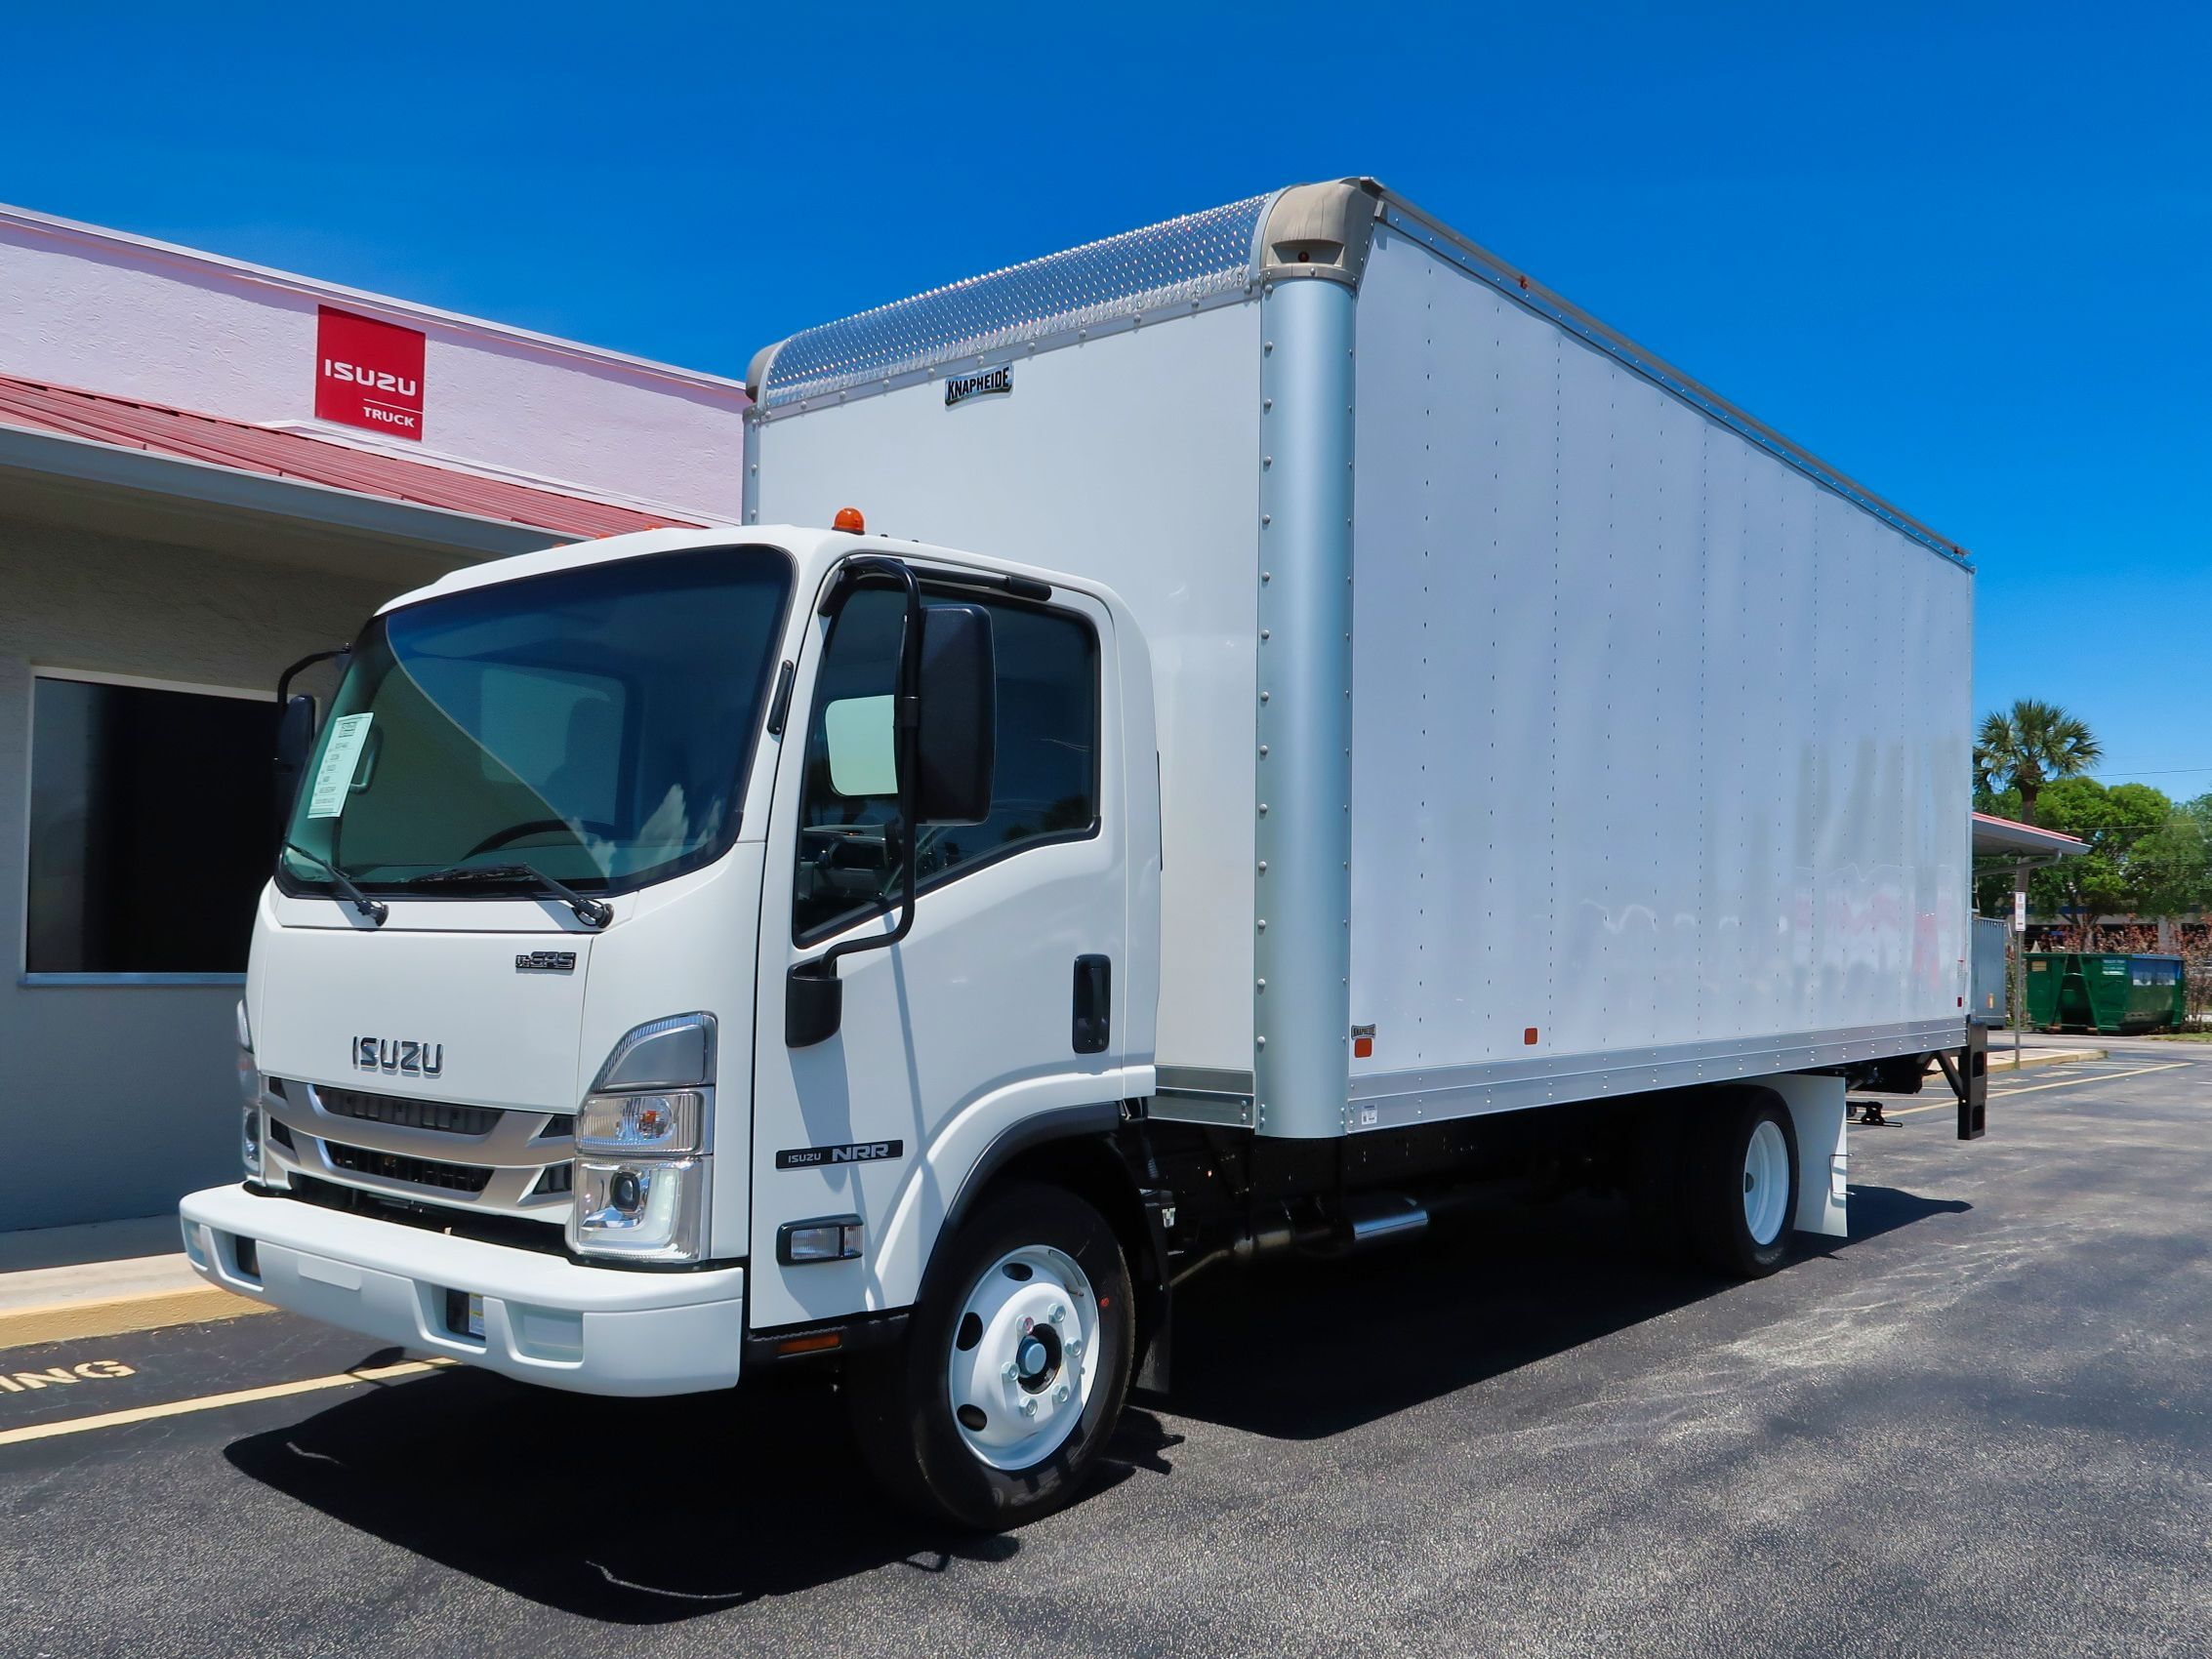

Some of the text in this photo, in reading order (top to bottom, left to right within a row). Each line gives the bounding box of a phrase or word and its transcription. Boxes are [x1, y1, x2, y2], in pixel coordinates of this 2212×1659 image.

[324, 358, 416, 396] ISUZU
[947, 367, 1010, 401] KNAPHEIDE
[362, 406, 415, 427] TRUCK
[352, 1035, 444, 1075] ISUZU
[788, 1143, 889, 1164] ISUZU NRR
[0, 1359, 137, 1394] ING
